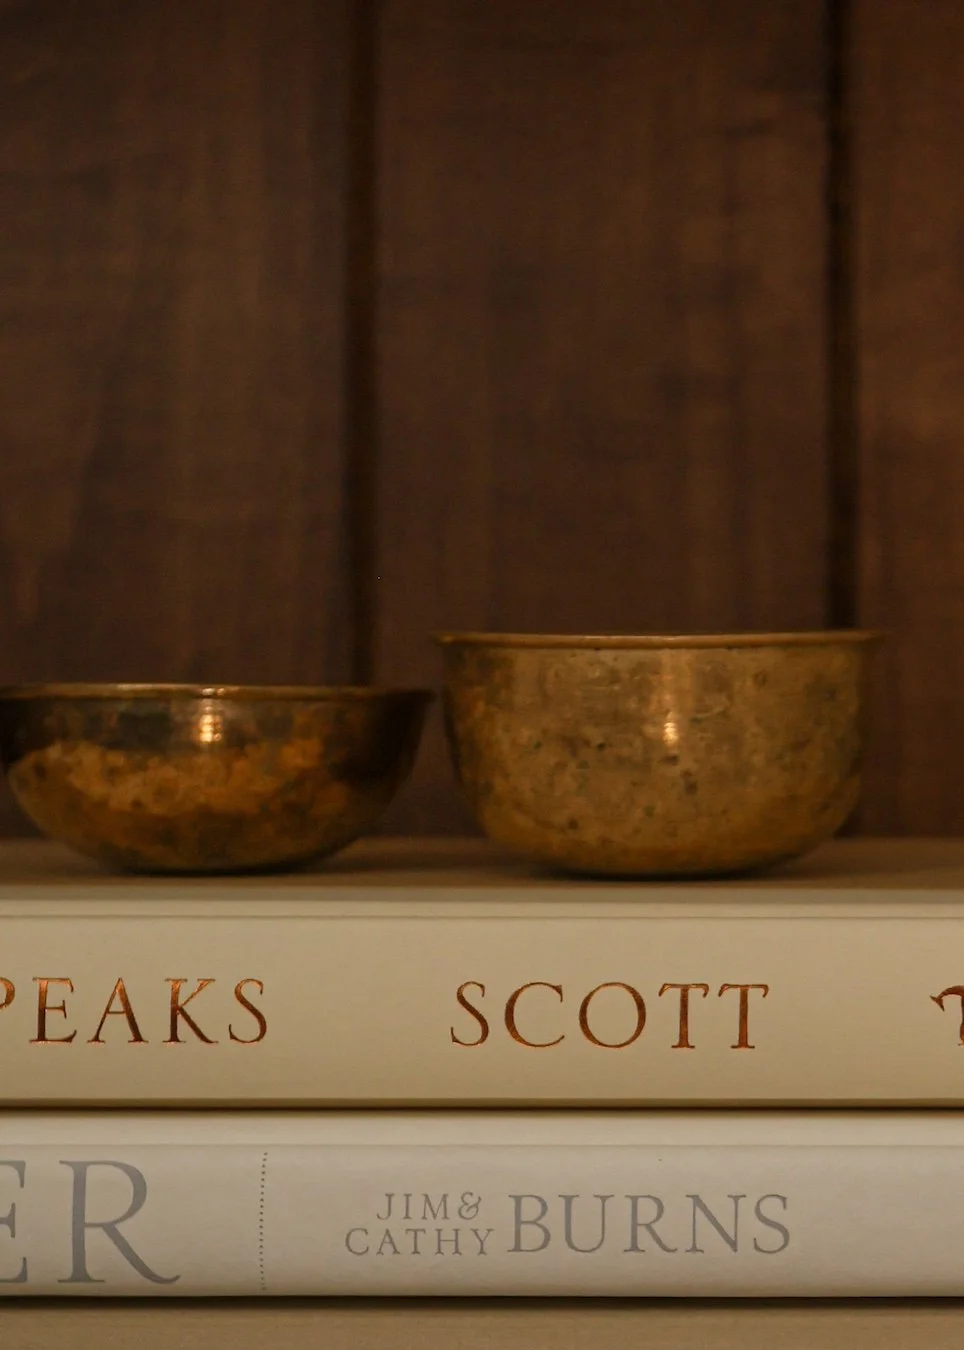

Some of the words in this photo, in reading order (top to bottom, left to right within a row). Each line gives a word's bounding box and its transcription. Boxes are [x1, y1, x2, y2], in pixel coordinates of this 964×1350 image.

[450, 981, 769, 1049] SCOTT
[345, 1227, 494, 1256] CATHY
[507, 1193, 790, 1255] BURNS
